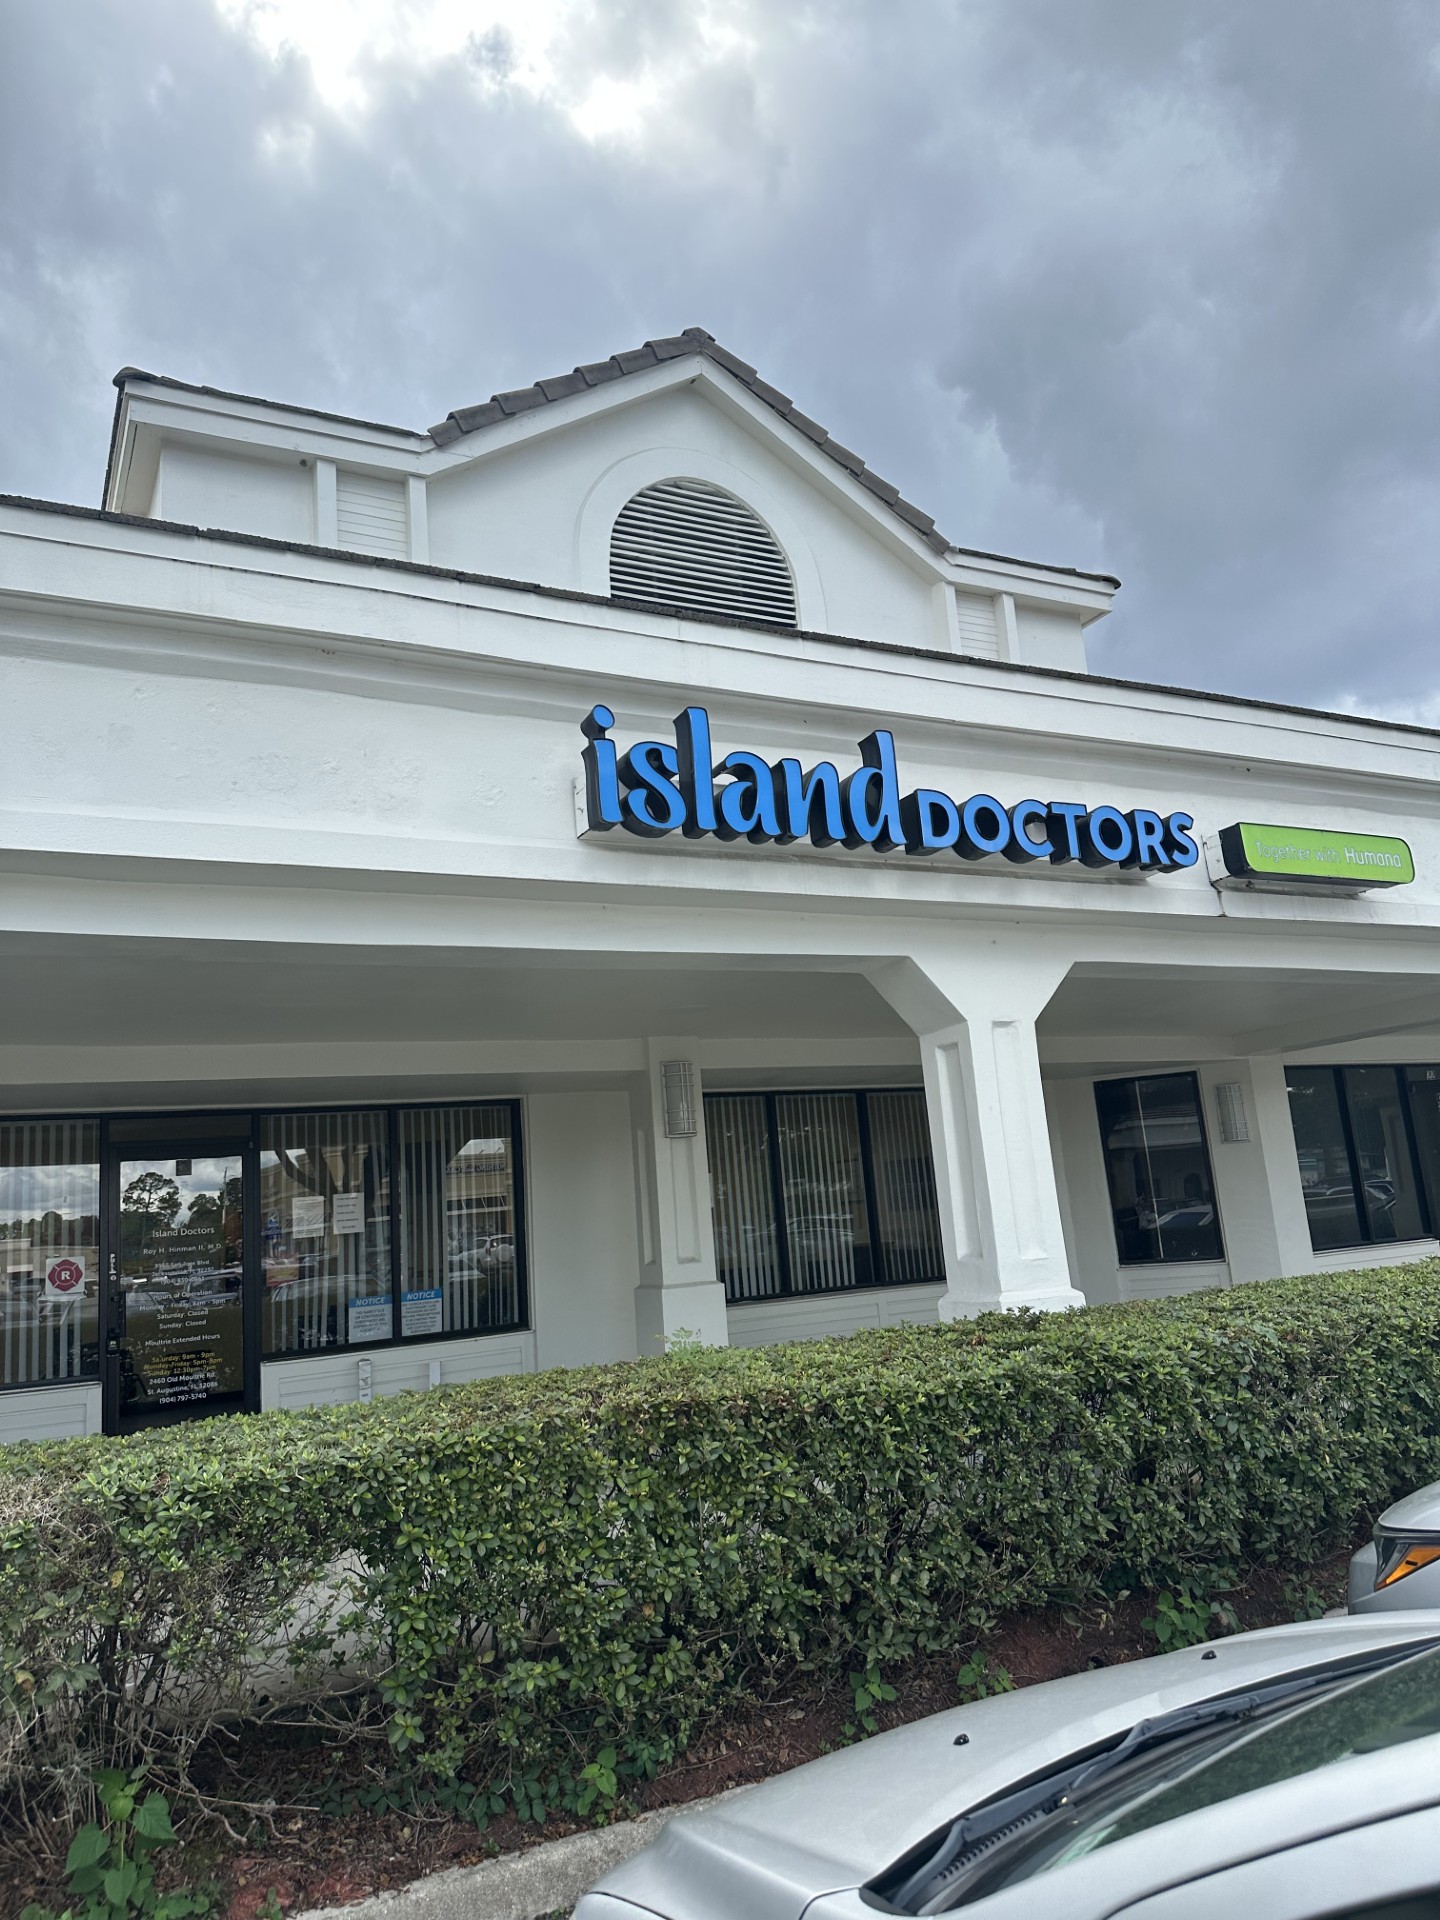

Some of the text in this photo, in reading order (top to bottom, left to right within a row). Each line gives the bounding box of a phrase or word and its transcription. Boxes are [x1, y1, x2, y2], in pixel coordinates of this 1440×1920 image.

[588, 703, 1199, 868] island DOCTORS
[1255, 840, 1402, 868] Together with Humana
[152, 1227, 215, 1238] Island Doctors
[143, 1248, 157, 1256] Roy
[169, 1245, 197, 1253] Hinman
[61, 1270, 71, 1280] R
[181, 1289, 213, 1298] Operation
[406, 1290, 436, 1300] NOTICE
[355, 1296, 386, 1306] NOTICE
[140, 1303, 165, 1312] Monday
[187, 1308, 209, 1317] Closed
[185, 1319, 207, 1327] Closed
[145, 1337, 172, 1347] Moultrie
[172, 1335, 201, 1344] Extended
[201, 1351, 216, 1359] 9pm
[149, 1377, 166, 1385] 2460
[166, 1375, 178, 1383] Old
[179, 1372, 205, 1381] Moultrie
[159, 1392, 207, 1404] (904) 797-5740
